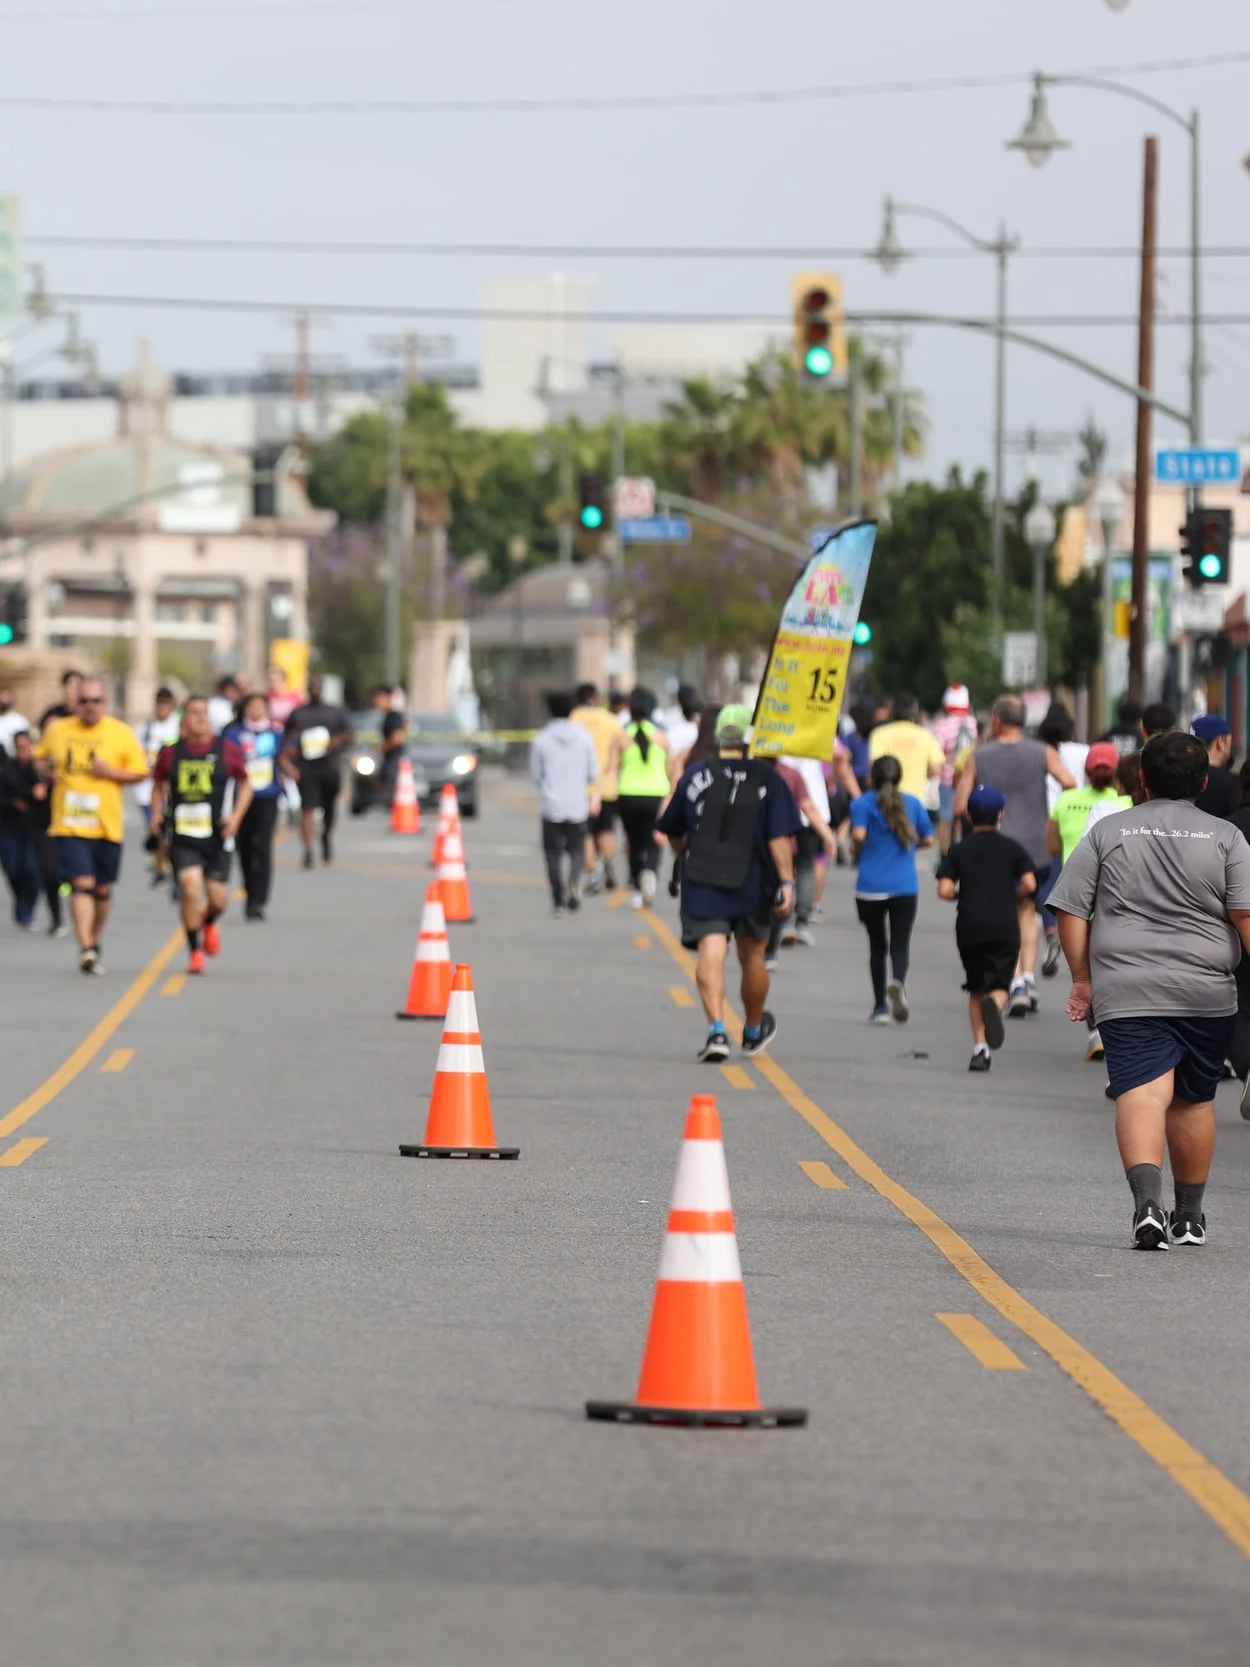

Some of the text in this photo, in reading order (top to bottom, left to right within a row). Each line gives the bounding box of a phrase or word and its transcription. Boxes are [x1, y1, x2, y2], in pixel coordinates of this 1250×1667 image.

[806, 666, 838, 704] 15
[764, 697, 790, 713] The
[759, 718, 795, 736] Long
[1140, 827, 1152, 835] for
